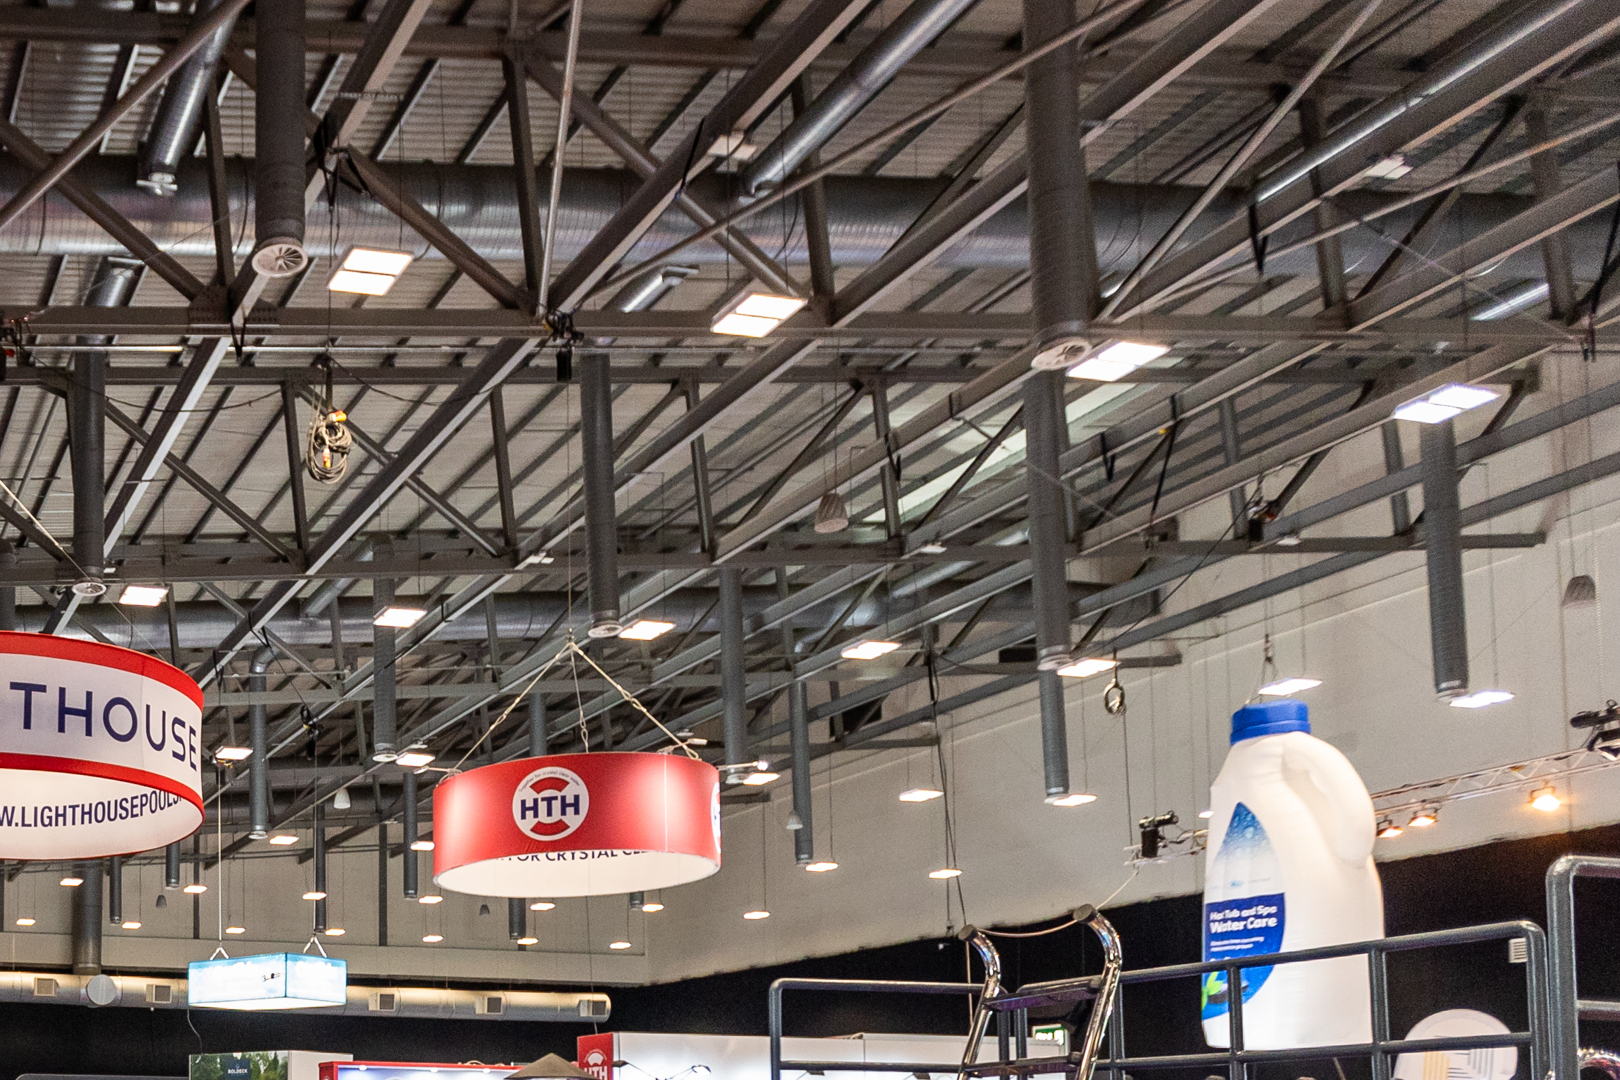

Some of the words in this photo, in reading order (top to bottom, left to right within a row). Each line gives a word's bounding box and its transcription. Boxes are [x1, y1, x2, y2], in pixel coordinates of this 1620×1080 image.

[520, 794, 580, 821] HTH
[1256, 905, 1278, 917] Spa
[1209, 920, 1247, 934] Water
[1246, 917, 1278, 930] Care
